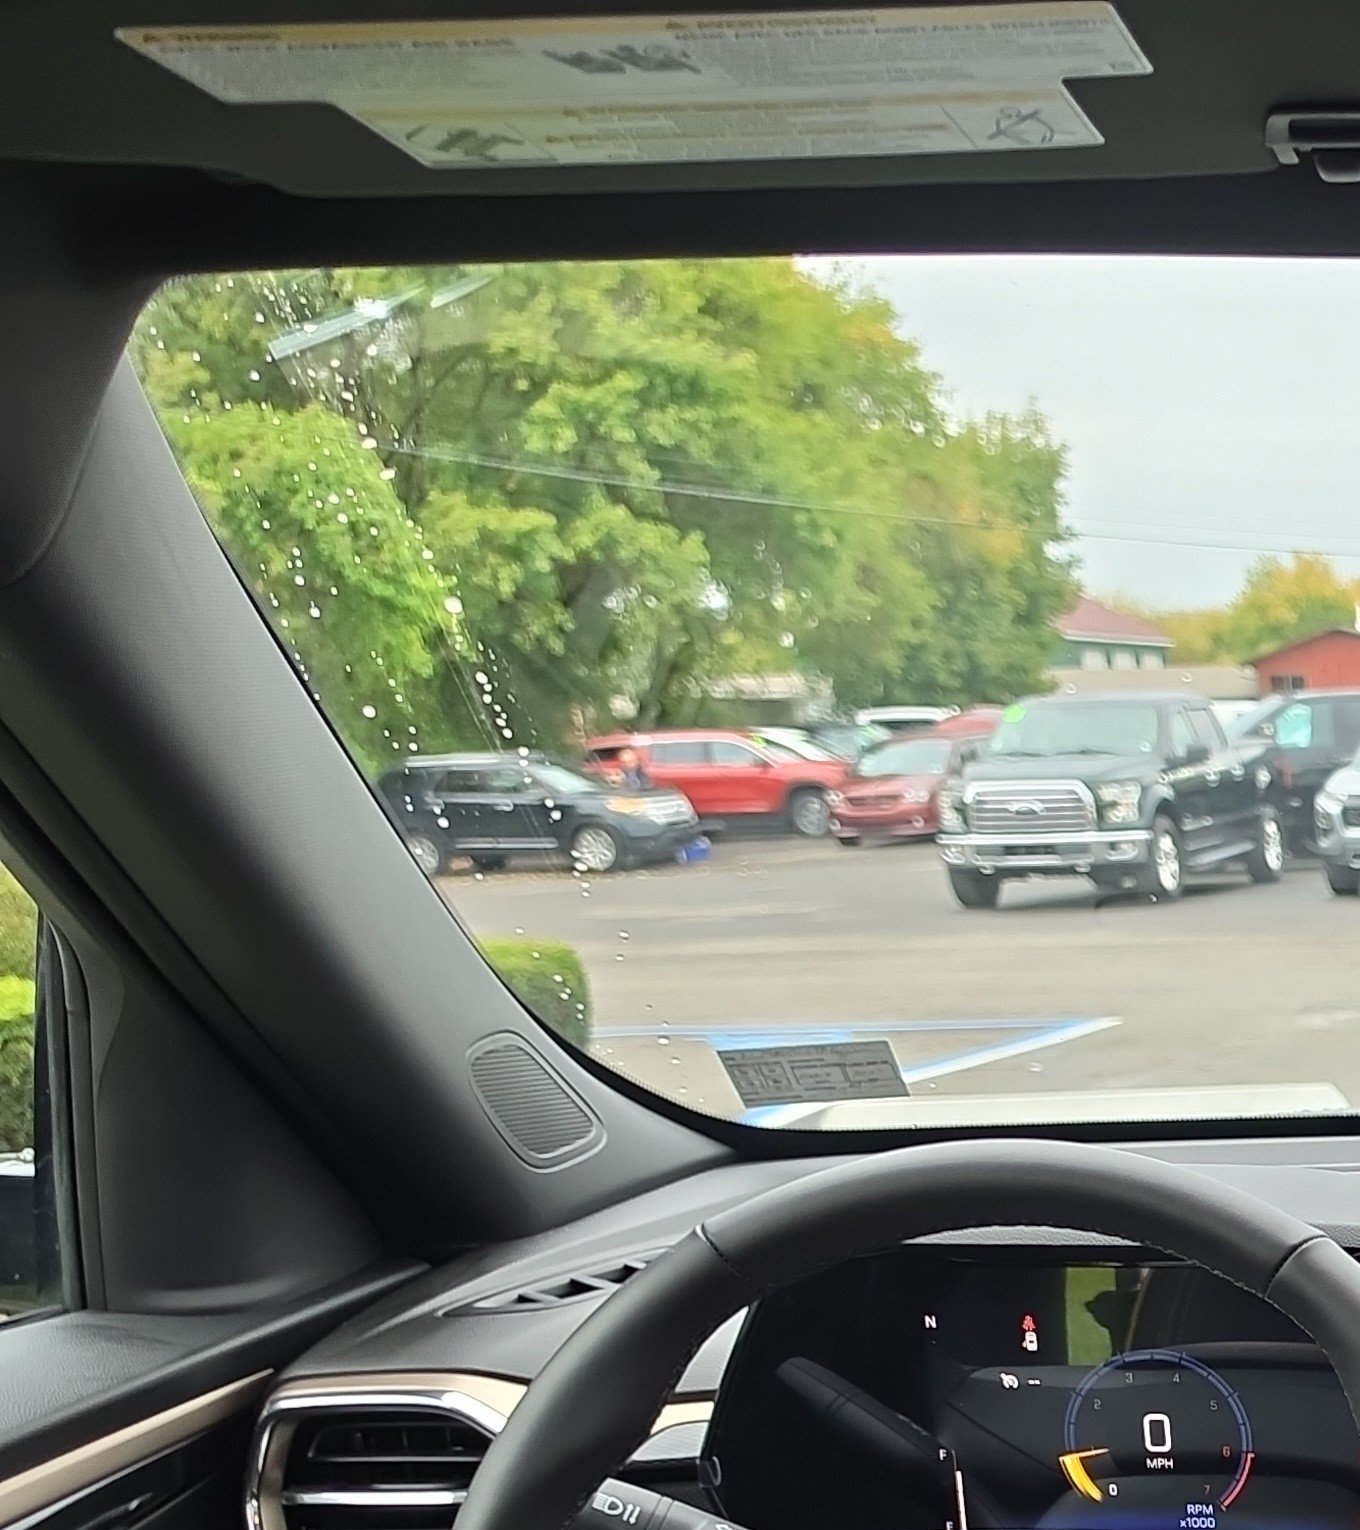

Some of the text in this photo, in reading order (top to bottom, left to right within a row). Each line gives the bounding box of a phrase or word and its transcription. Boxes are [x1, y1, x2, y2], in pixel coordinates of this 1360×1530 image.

[924, 1314, 937, 1329] N
[1125, 1372, 1133, 1383] 3
[1173, 1373, 1180, 1383] 4
[1093, 1399, 1102, 1410] 2
[1210, 1400, 1218, 1411] 5
[1143, 1413, 1172, 1453] 0
[939, 1448, 947, 1460] F
[1222, 1446, 1231, 1457] 6
[1146, 1458, 1174, 1469] MPH
[1108, 1484, 1118, 1496] 0
[1204, 1484, 1211, 1495] 7
[1187, 1504, 1214, 1515] RPM
[1180, 1517, 1216, 1529] x1000
